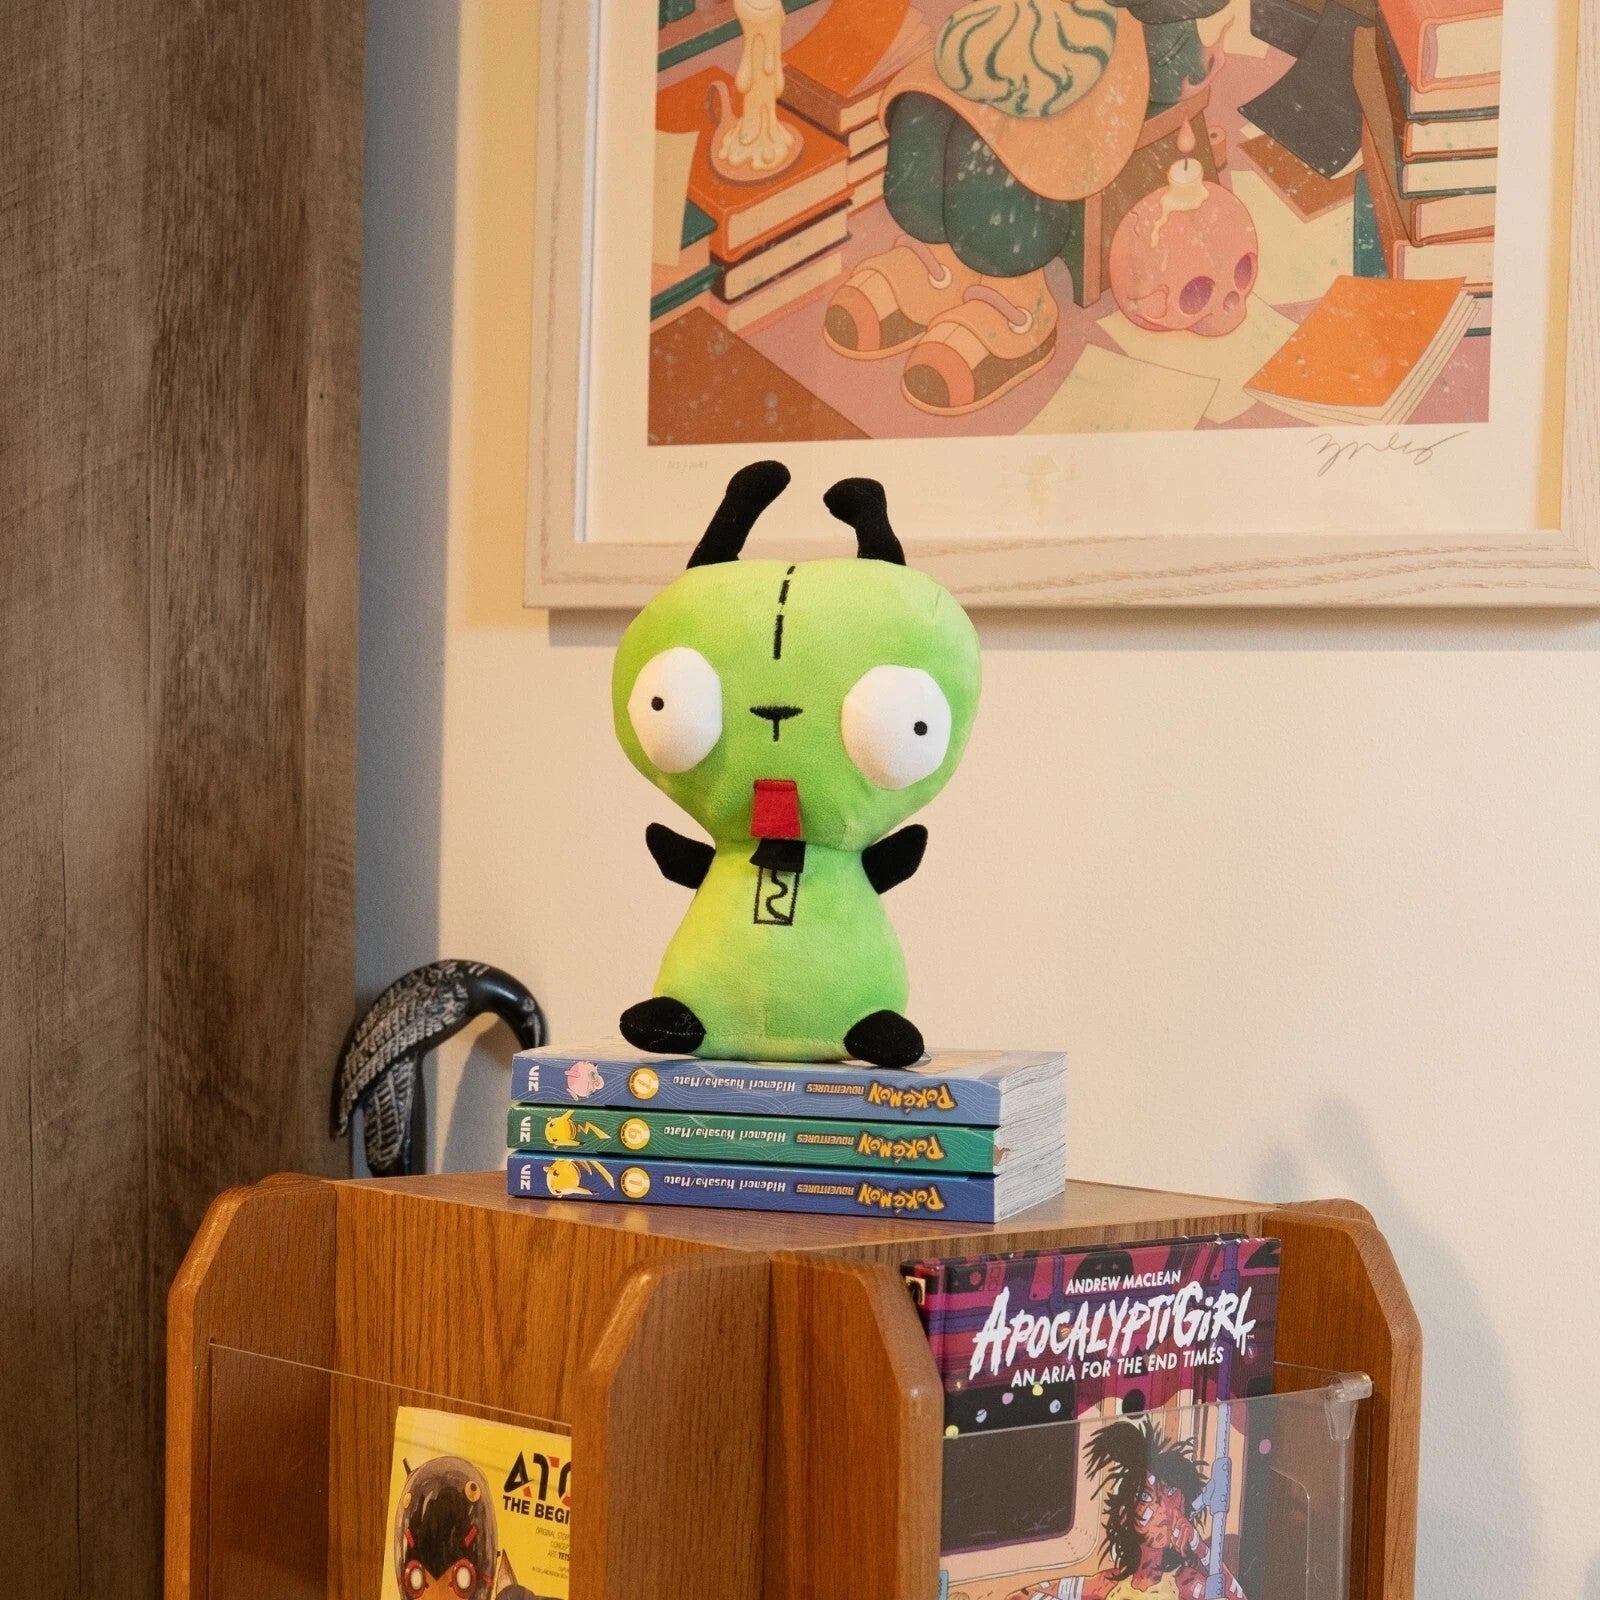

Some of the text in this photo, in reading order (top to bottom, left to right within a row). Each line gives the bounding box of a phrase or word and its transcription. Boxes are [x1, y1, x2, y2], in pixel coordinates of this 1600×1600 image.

[528, 1065, 540, 1092] VIZ
[749, 1079, 796, 1092] Hidenori
[806, 1083, 865, 1095] ADVENTURES
[520, 1116, 531, 1142] VIZ
[739, 1130, 786, 1143] Hidenori
[796, 1133, 855, 1146] ADVENTURES
[520, 1164, 531, 1190] VIZ
[739, 1180, 786, 1193] Hidenori
[796, 1183, 855, 1196] ADVENTURES
[1065, 1269, 1182, 1296] ANDREW MACLEAN
[1011, 1346, 1225, 1388] AN ARIA FOR THE END TIMES
[503, 1495, 571, 1525] THE BEGI
